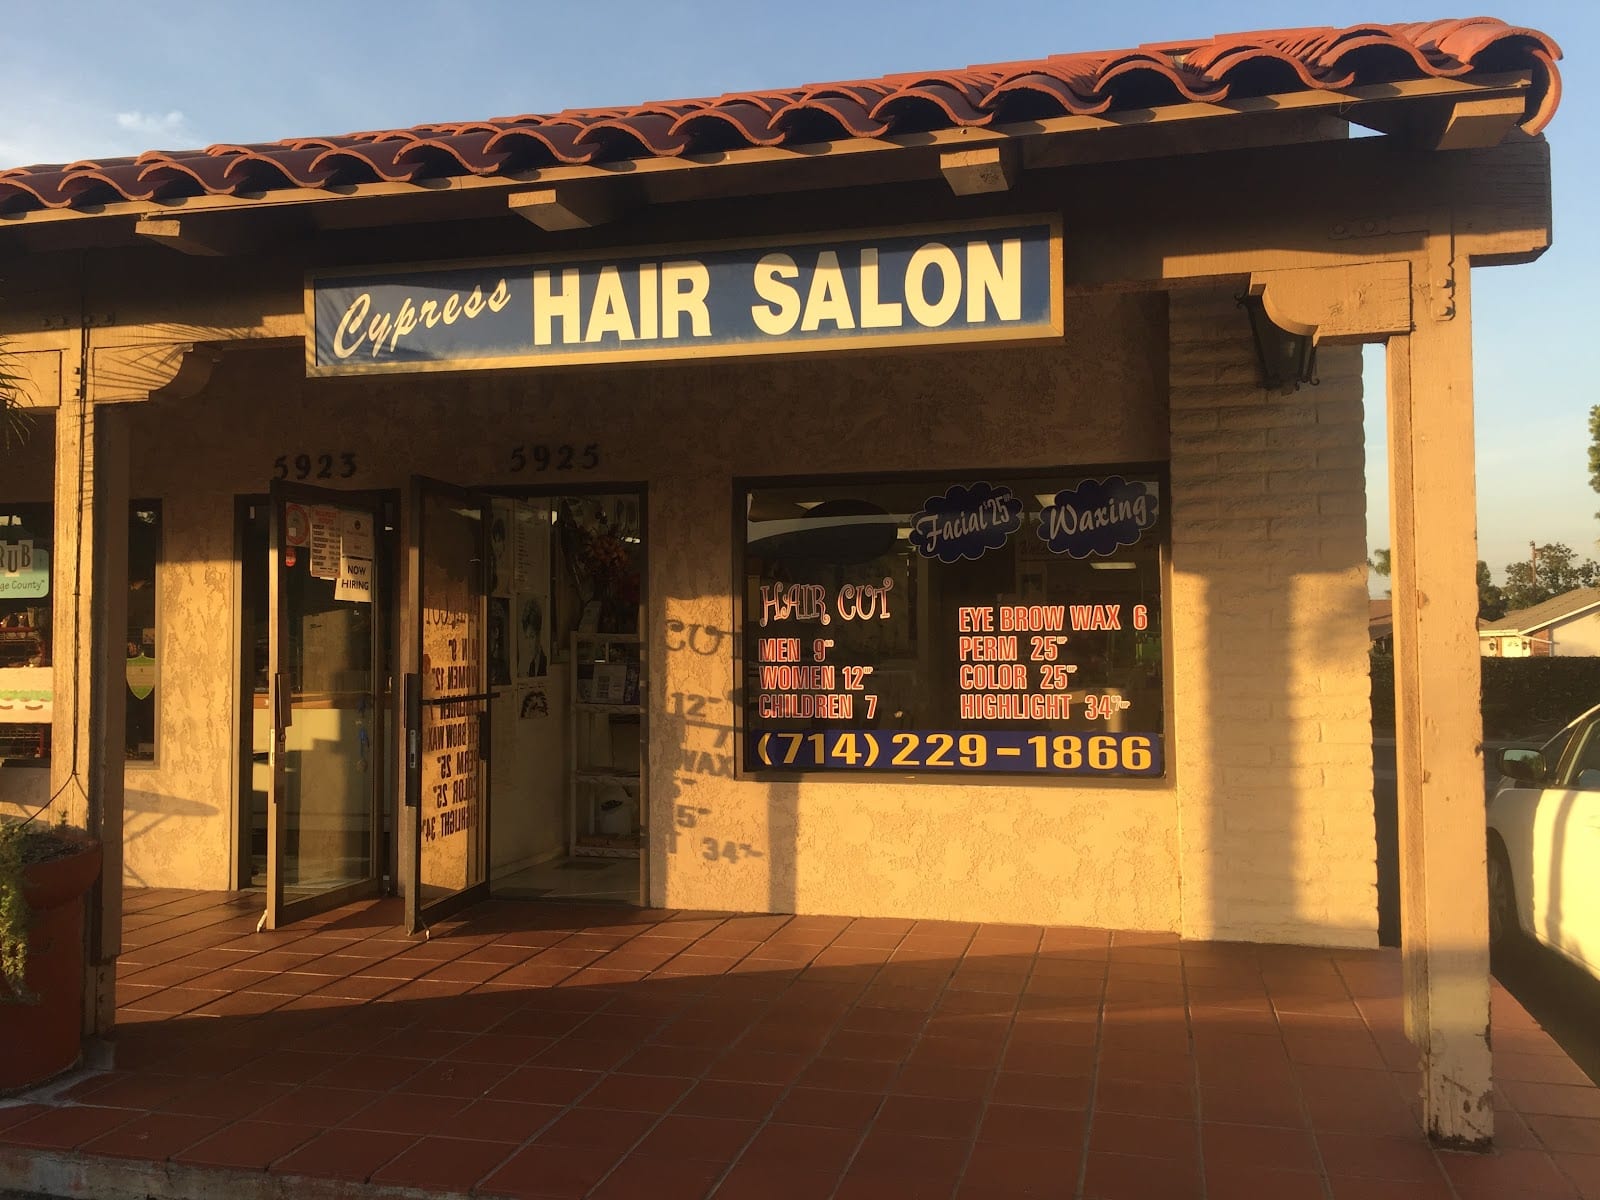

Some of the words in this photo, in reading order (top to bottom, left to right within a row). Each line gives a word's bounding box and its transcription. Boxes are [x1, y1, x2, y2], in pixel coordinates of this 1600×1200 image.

[332, 276, 511, 358] Cypress
[532, 259, 712, 346] HAIR
[751, 237, 1023, 337] SALON
[274, 453, 357, 480] 5923
[511, 444, 600, 472] 5925
[916, 505, 988, 552] Facial
[1049, 495, 1147, 539] Waxing
[348, 565, 366, 575] NOW
[341, 579, 369, 590] HIRING
[760, 581, 831, 627] HAIR
[837, 577, 894, 620] CUT
[958, 606, 994, 632] EYE
[1000, 605, 1065, 632] BROW
[1069, 604, 1121, 631] WAX
[1133, 604, 1148, 631] 6
[759, 638, 800, 662] MEN
[959, 636, 1018, 662] PERM
[759, 665, 835, 690] WOMEN
[960, 664, 1027, 690] COLOR
[759, 694, 853, 719] CHILDREN
[864, 695, 878, 719] 7
[960, 694, 1072, 720] HIGHLIGHT
[757, 732, 880, 767] (714)
